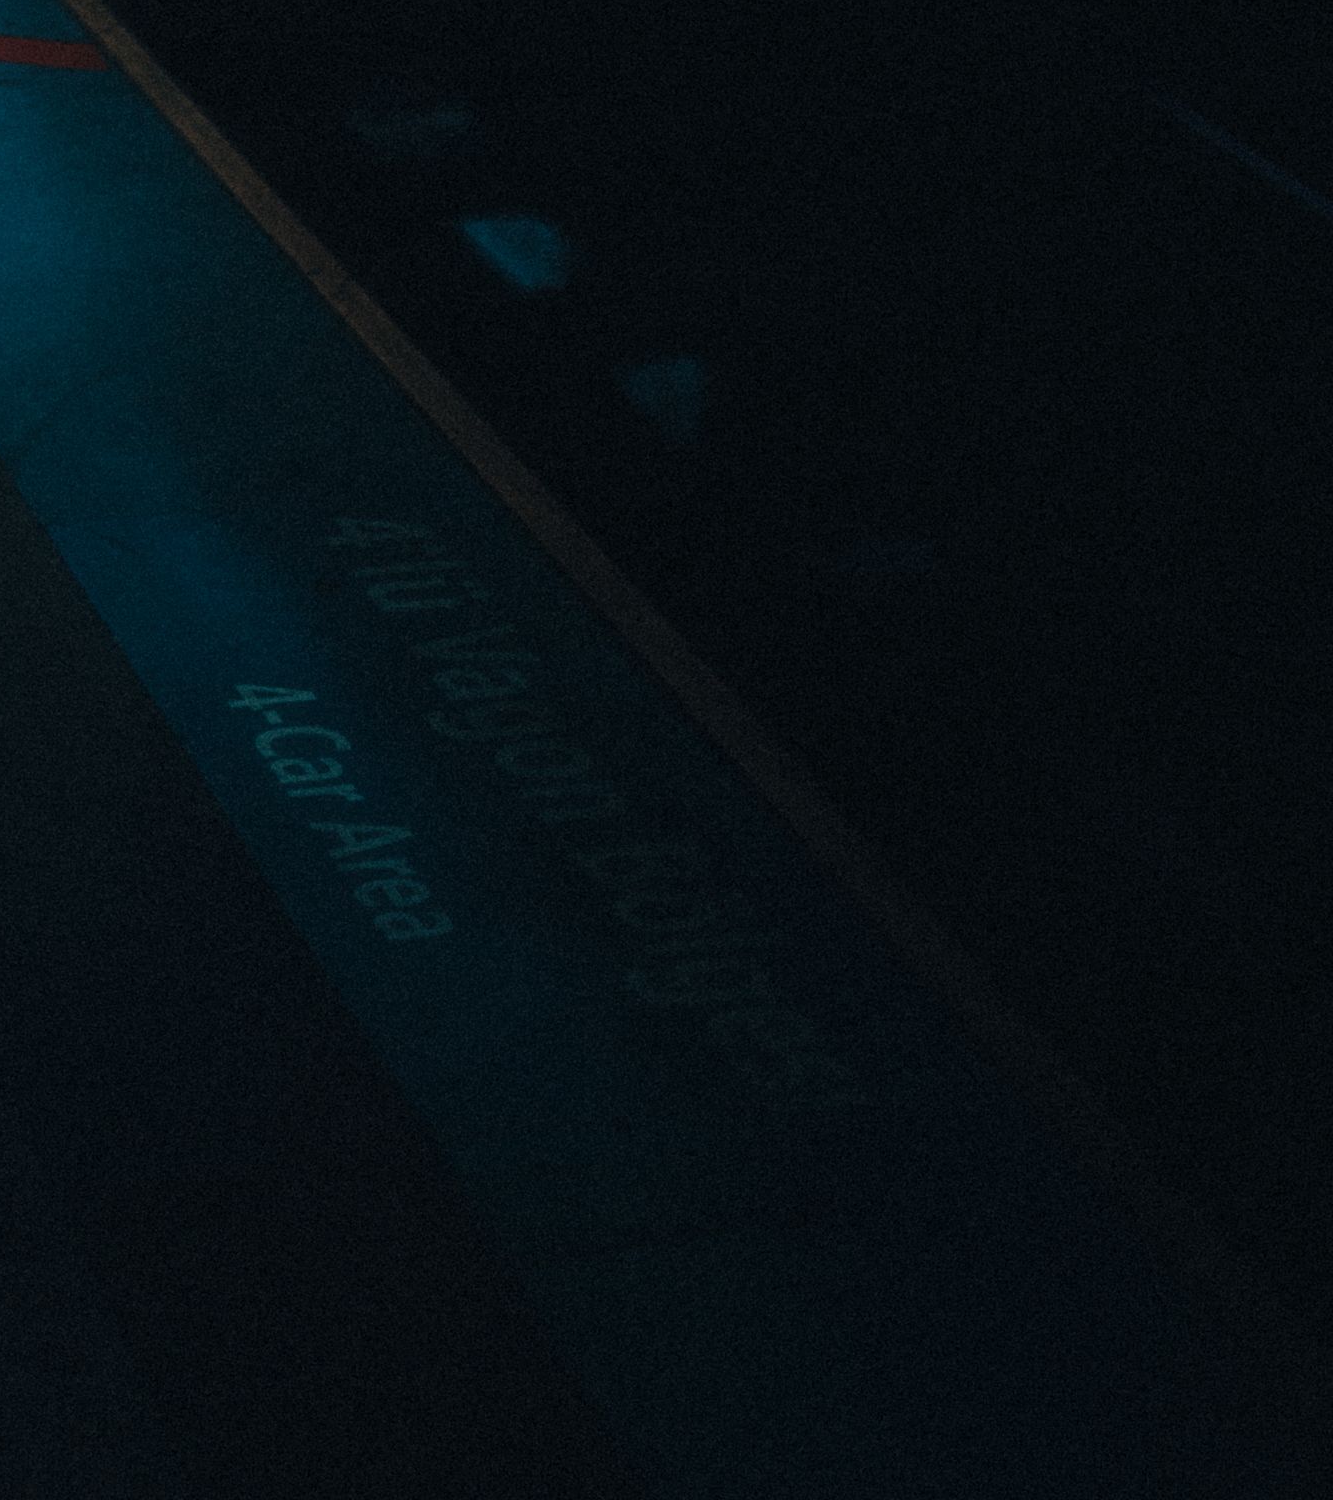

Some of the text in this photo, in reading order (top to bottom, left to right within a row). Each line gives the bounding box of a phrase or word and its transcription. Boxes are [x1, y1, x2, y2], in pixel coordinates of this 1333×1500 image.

[227, 681, 454, 943] 4-Car Area
[409, 620, 629, 827] Vagon
